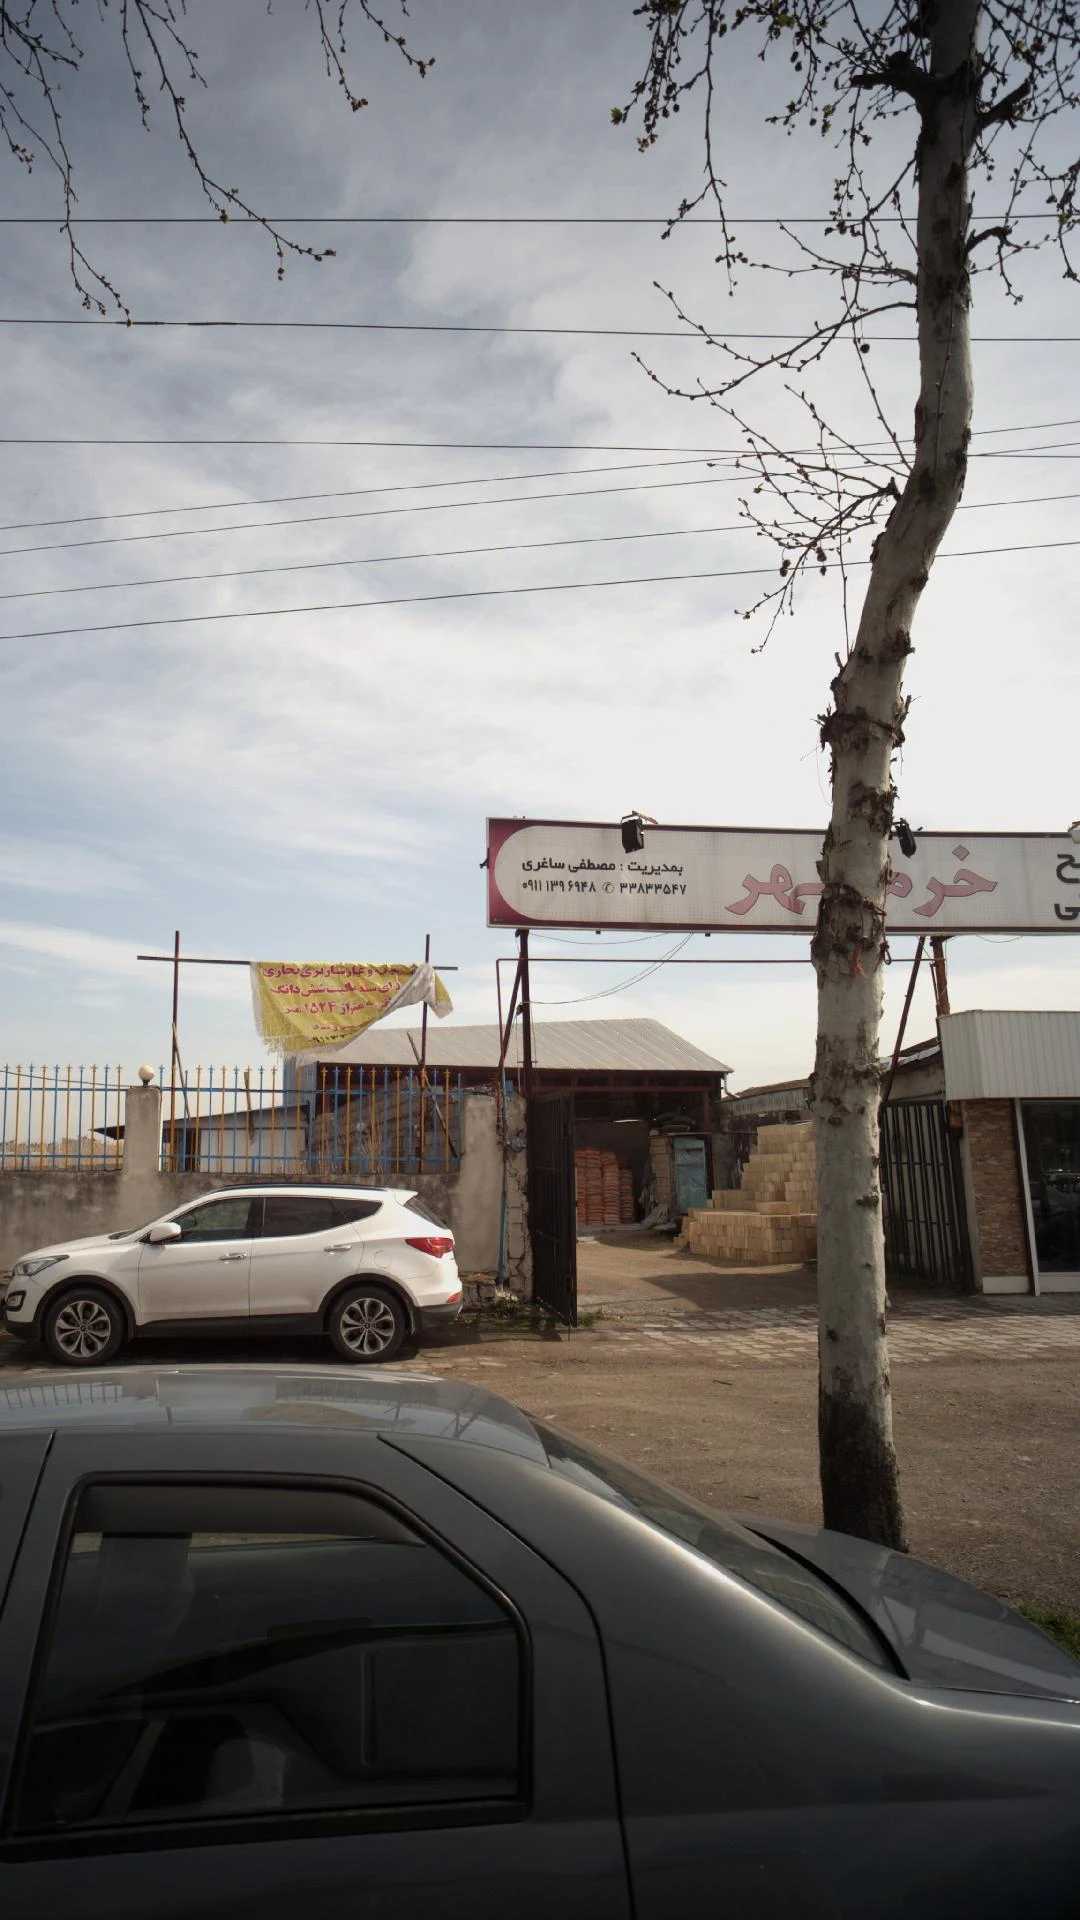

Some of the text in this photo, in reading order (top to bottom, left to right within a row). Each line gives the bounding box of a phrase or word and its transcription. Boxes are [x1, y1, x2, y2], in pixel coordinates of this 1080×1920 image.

[521, 857, 565, 872] ساغری
[568, 858, 616, 873] مصطفی
[627, 861, 683, 876] بمدیریت
[724, 844, 998, 917] خرمهر
[619, 882, 687, 895] ۳۳۸۳۳۵۴۷
